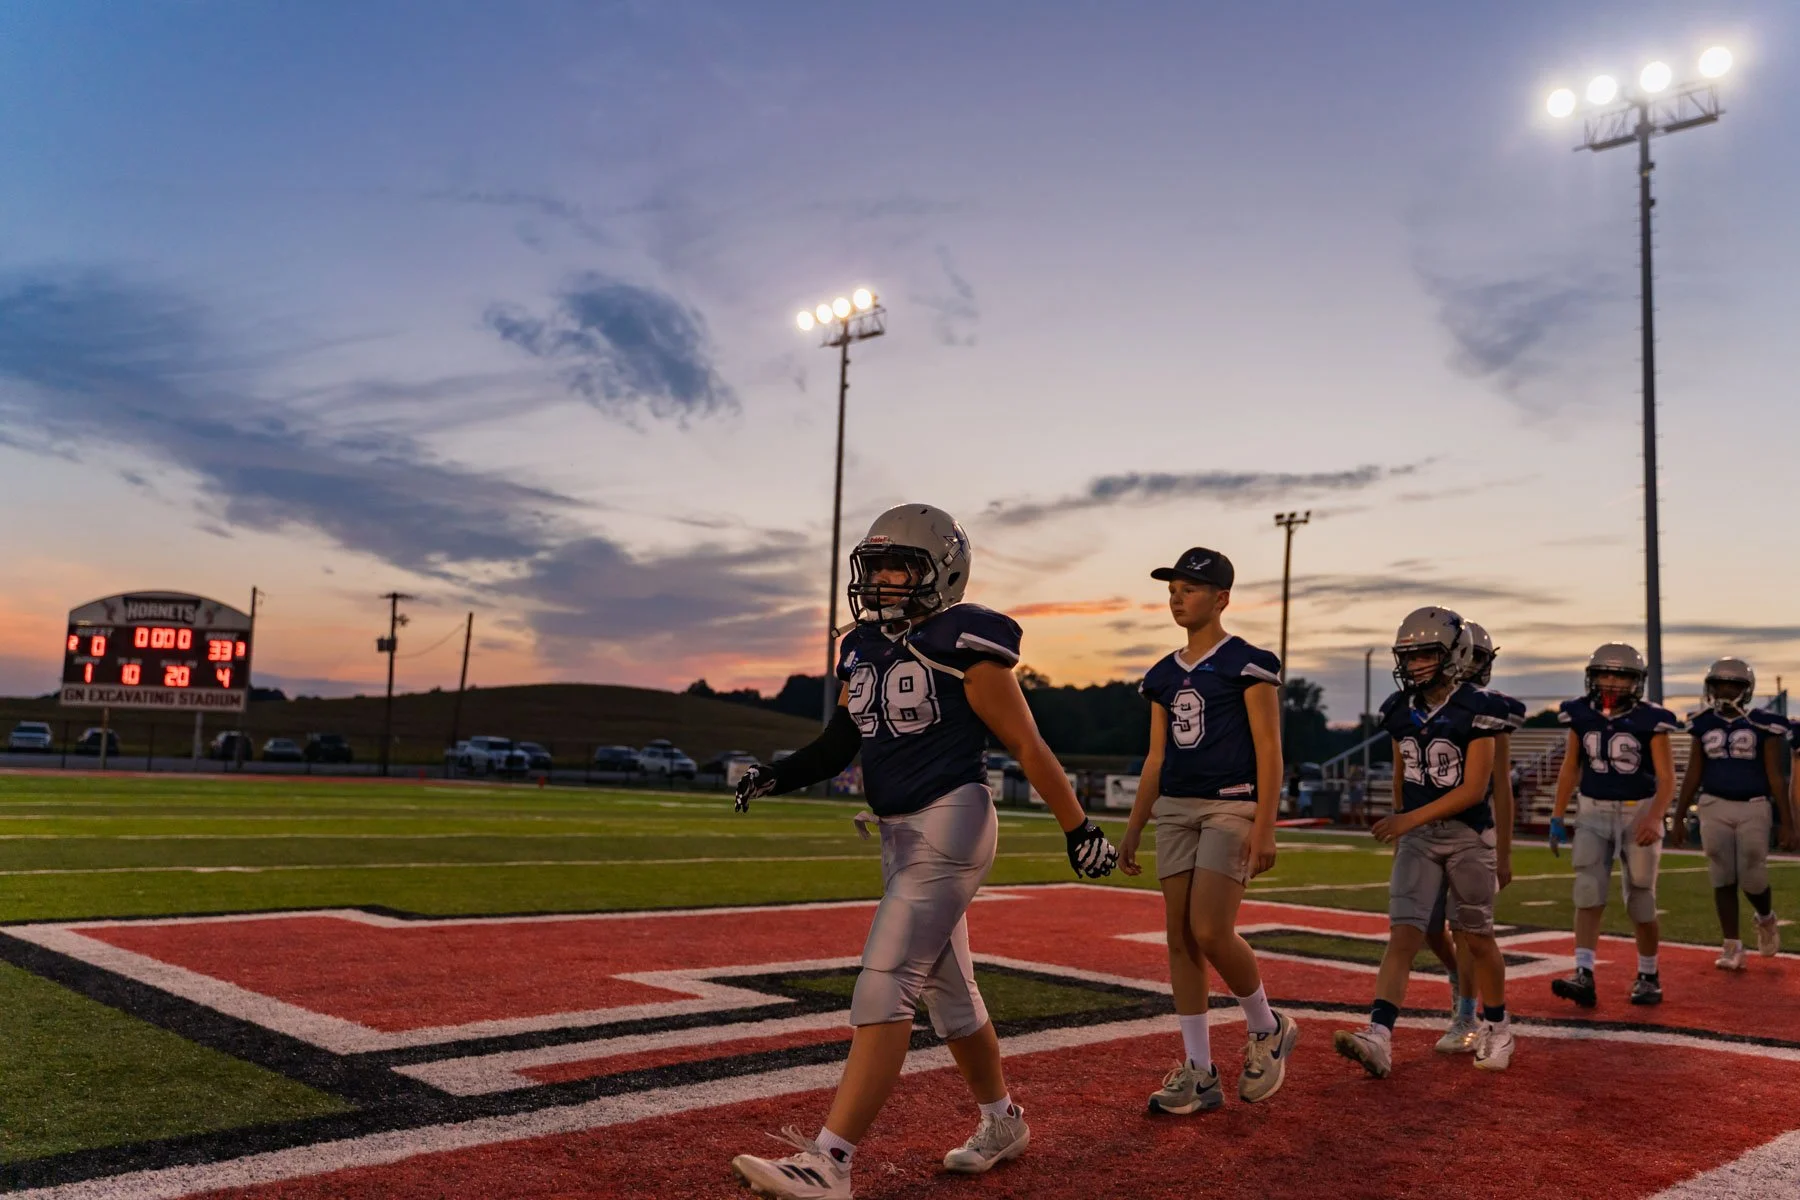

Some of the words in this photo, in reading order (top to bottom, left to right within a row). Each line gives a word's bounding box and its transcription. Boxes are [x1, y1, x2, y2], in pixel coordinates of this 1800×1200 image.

[127, 601, 196, 621] HORNETS
[91, 636, 106, 656] 0
[208, 640, 233, 661] 33
[83, 661, 94, 684] 1
[121, 663, 142, 685] 10
[164, 665, 190, 687] 20
[216, 668, 230, 689] 4
[89, 690, 175, 705] EXCAVATING
[179, 692, 242, 706] STADIUM
[847, 658, 941, 738] 28
[1171, 687, 1206, 749] 9
[1583, 731, 1643, 775] 16
[1702, 728, 1758, 760] 22
